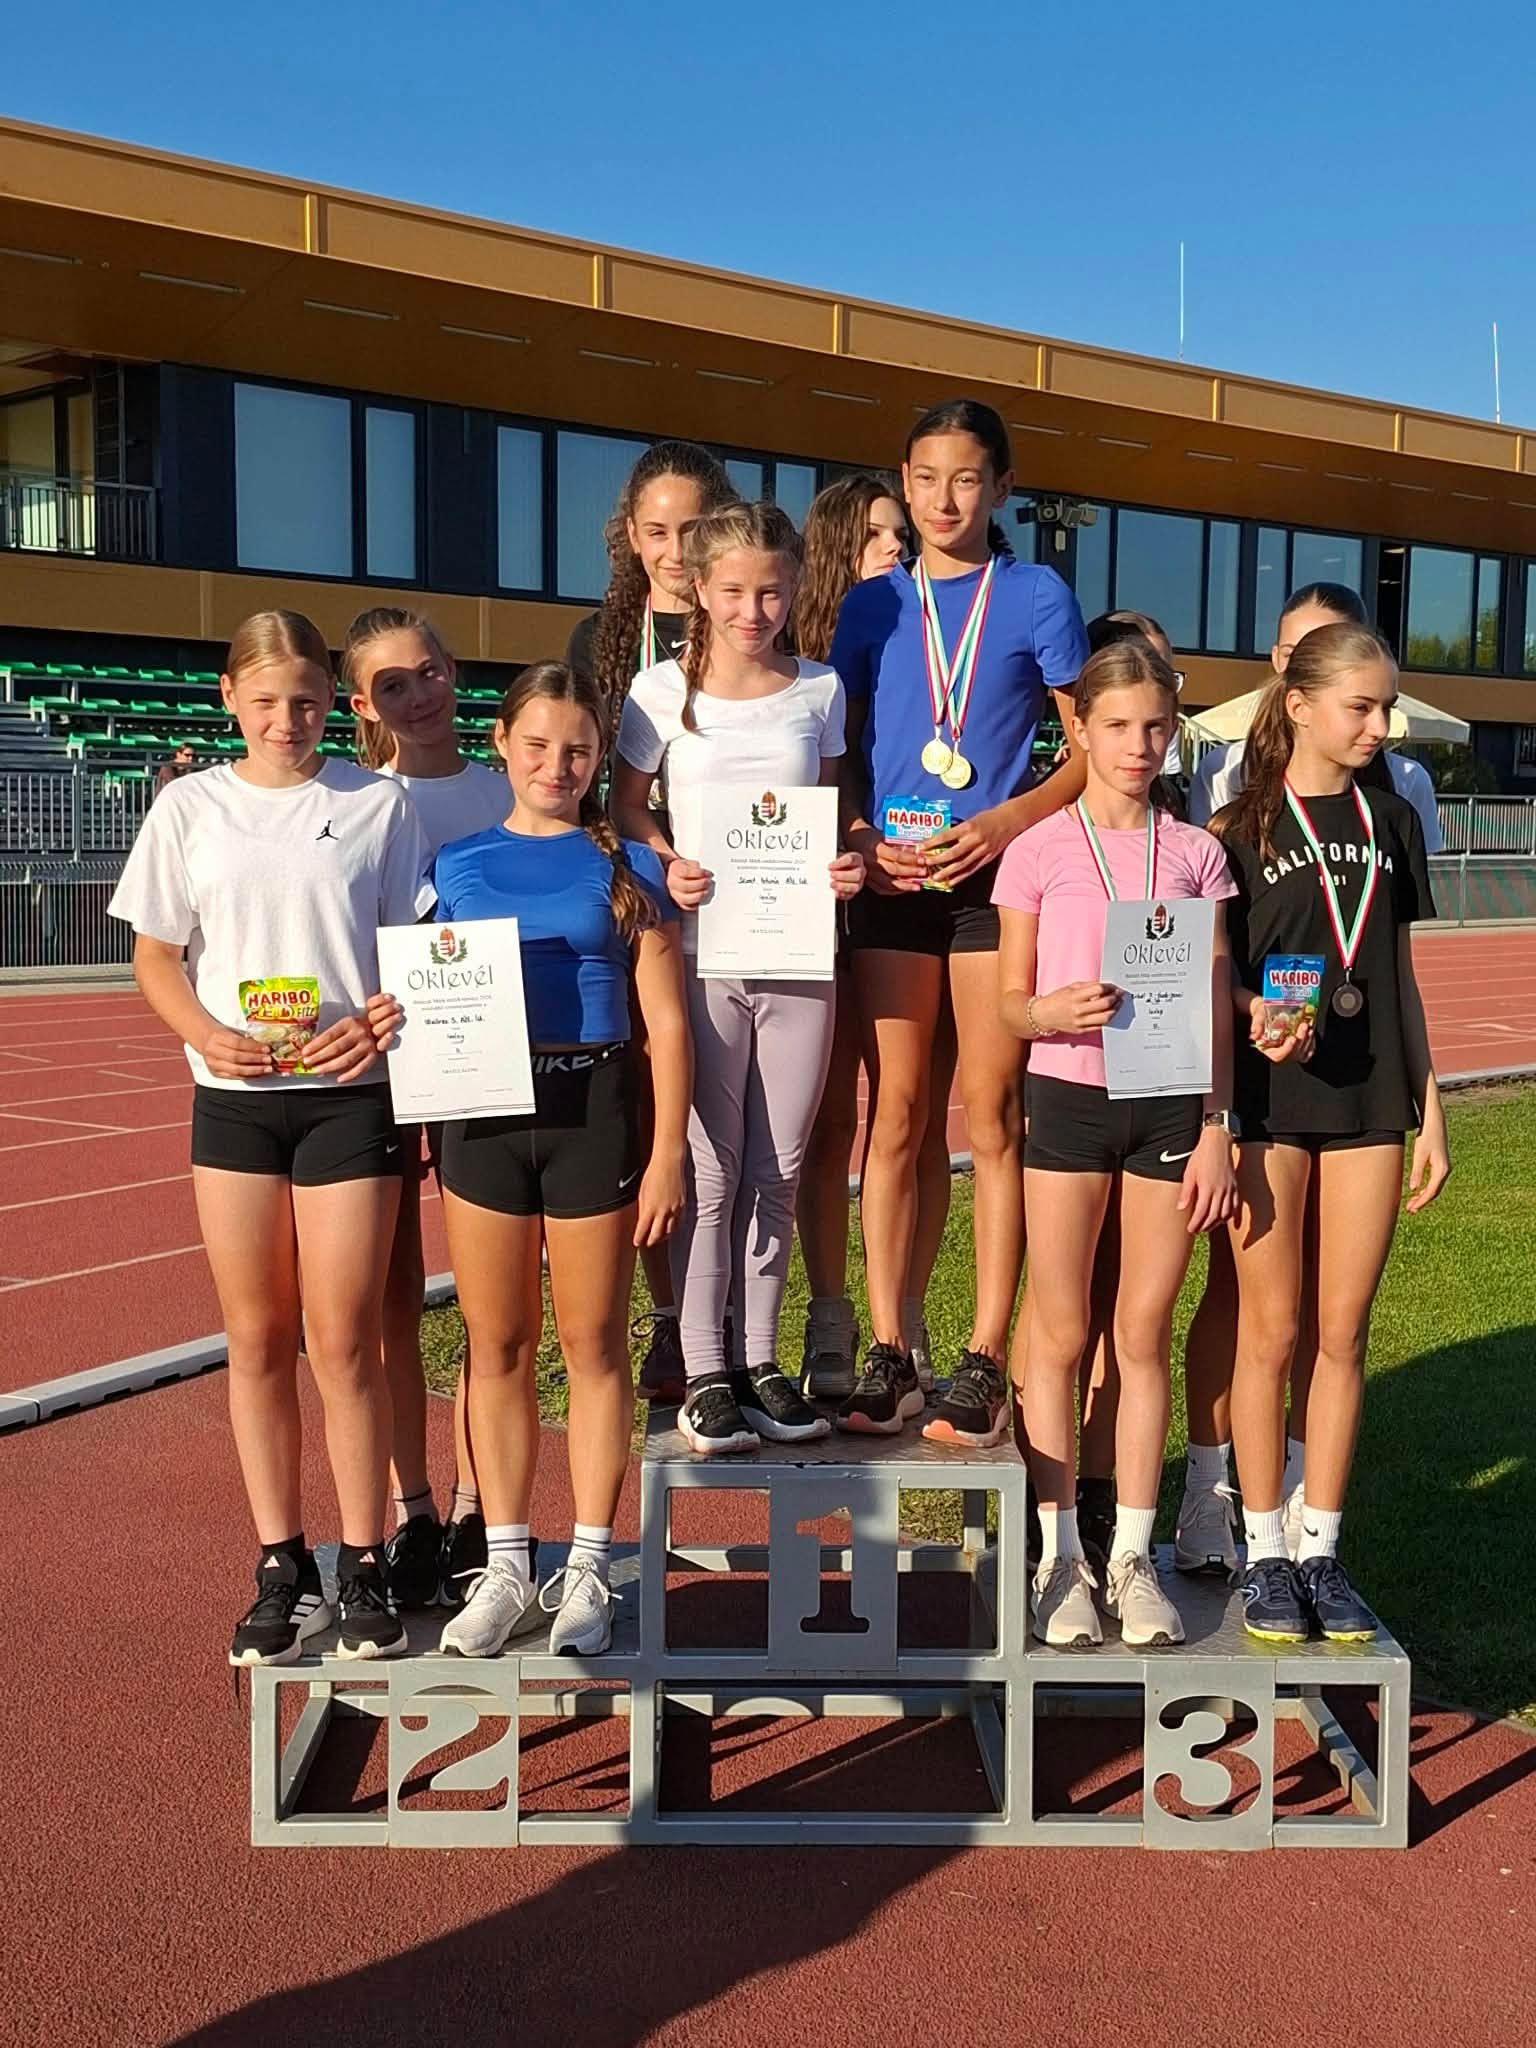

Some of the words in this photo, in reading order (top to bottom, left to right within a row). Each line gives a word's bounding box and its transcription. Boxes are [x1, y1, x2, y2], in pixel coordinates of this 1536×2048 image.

[888, 809, 944, 827] HARIBO
[726, 828, 809, 852] Oklevél
[1319, 874, 1347, 887] 191
[1123, 941, 1192, 966] Oklevél
[407, 964, 494, 991] Oklevél
[1271, 971, 1320, 986] HARIBO
[248, 989, 312, 1008] HARIBO
[795, 1505, 870, 1634] 1
[397, 1683, 513, 1813] 2
[1152, 1694, 1264, 1824] 3
